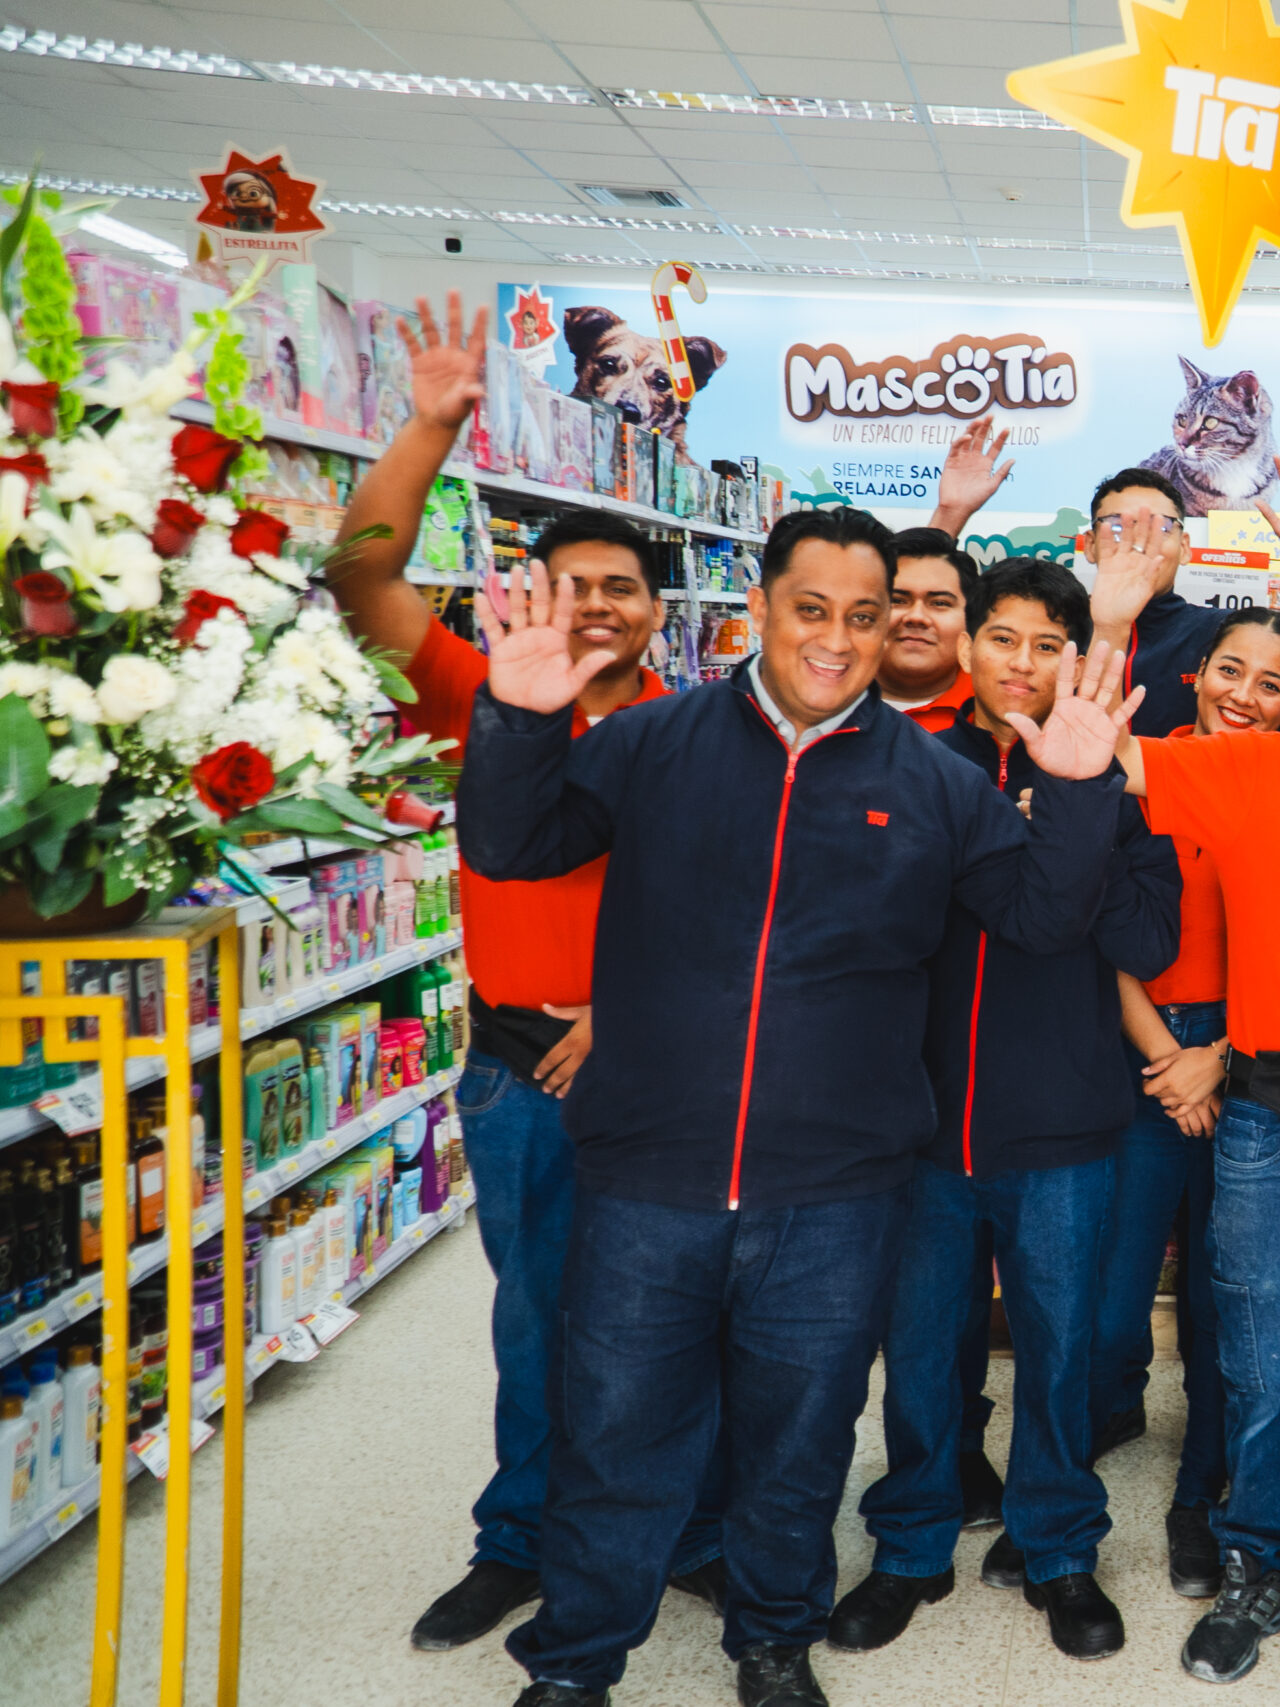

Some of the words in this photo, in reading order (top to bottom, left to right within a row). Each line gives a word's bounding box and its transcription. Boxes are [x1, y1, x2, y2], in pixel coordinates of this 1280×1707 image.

[224, 238, 298, 251] ESTRELLITA
[833, 423, 854, 442] UN
[861, 424, 913, 444] ESPACIO
[1003, 426, 1041, 446] LLOS
[832, 462, 905, 478] SIEMPRE
[910, 465, 942, 479] SAN
[833, 481, 927, 497] RELAJADO
